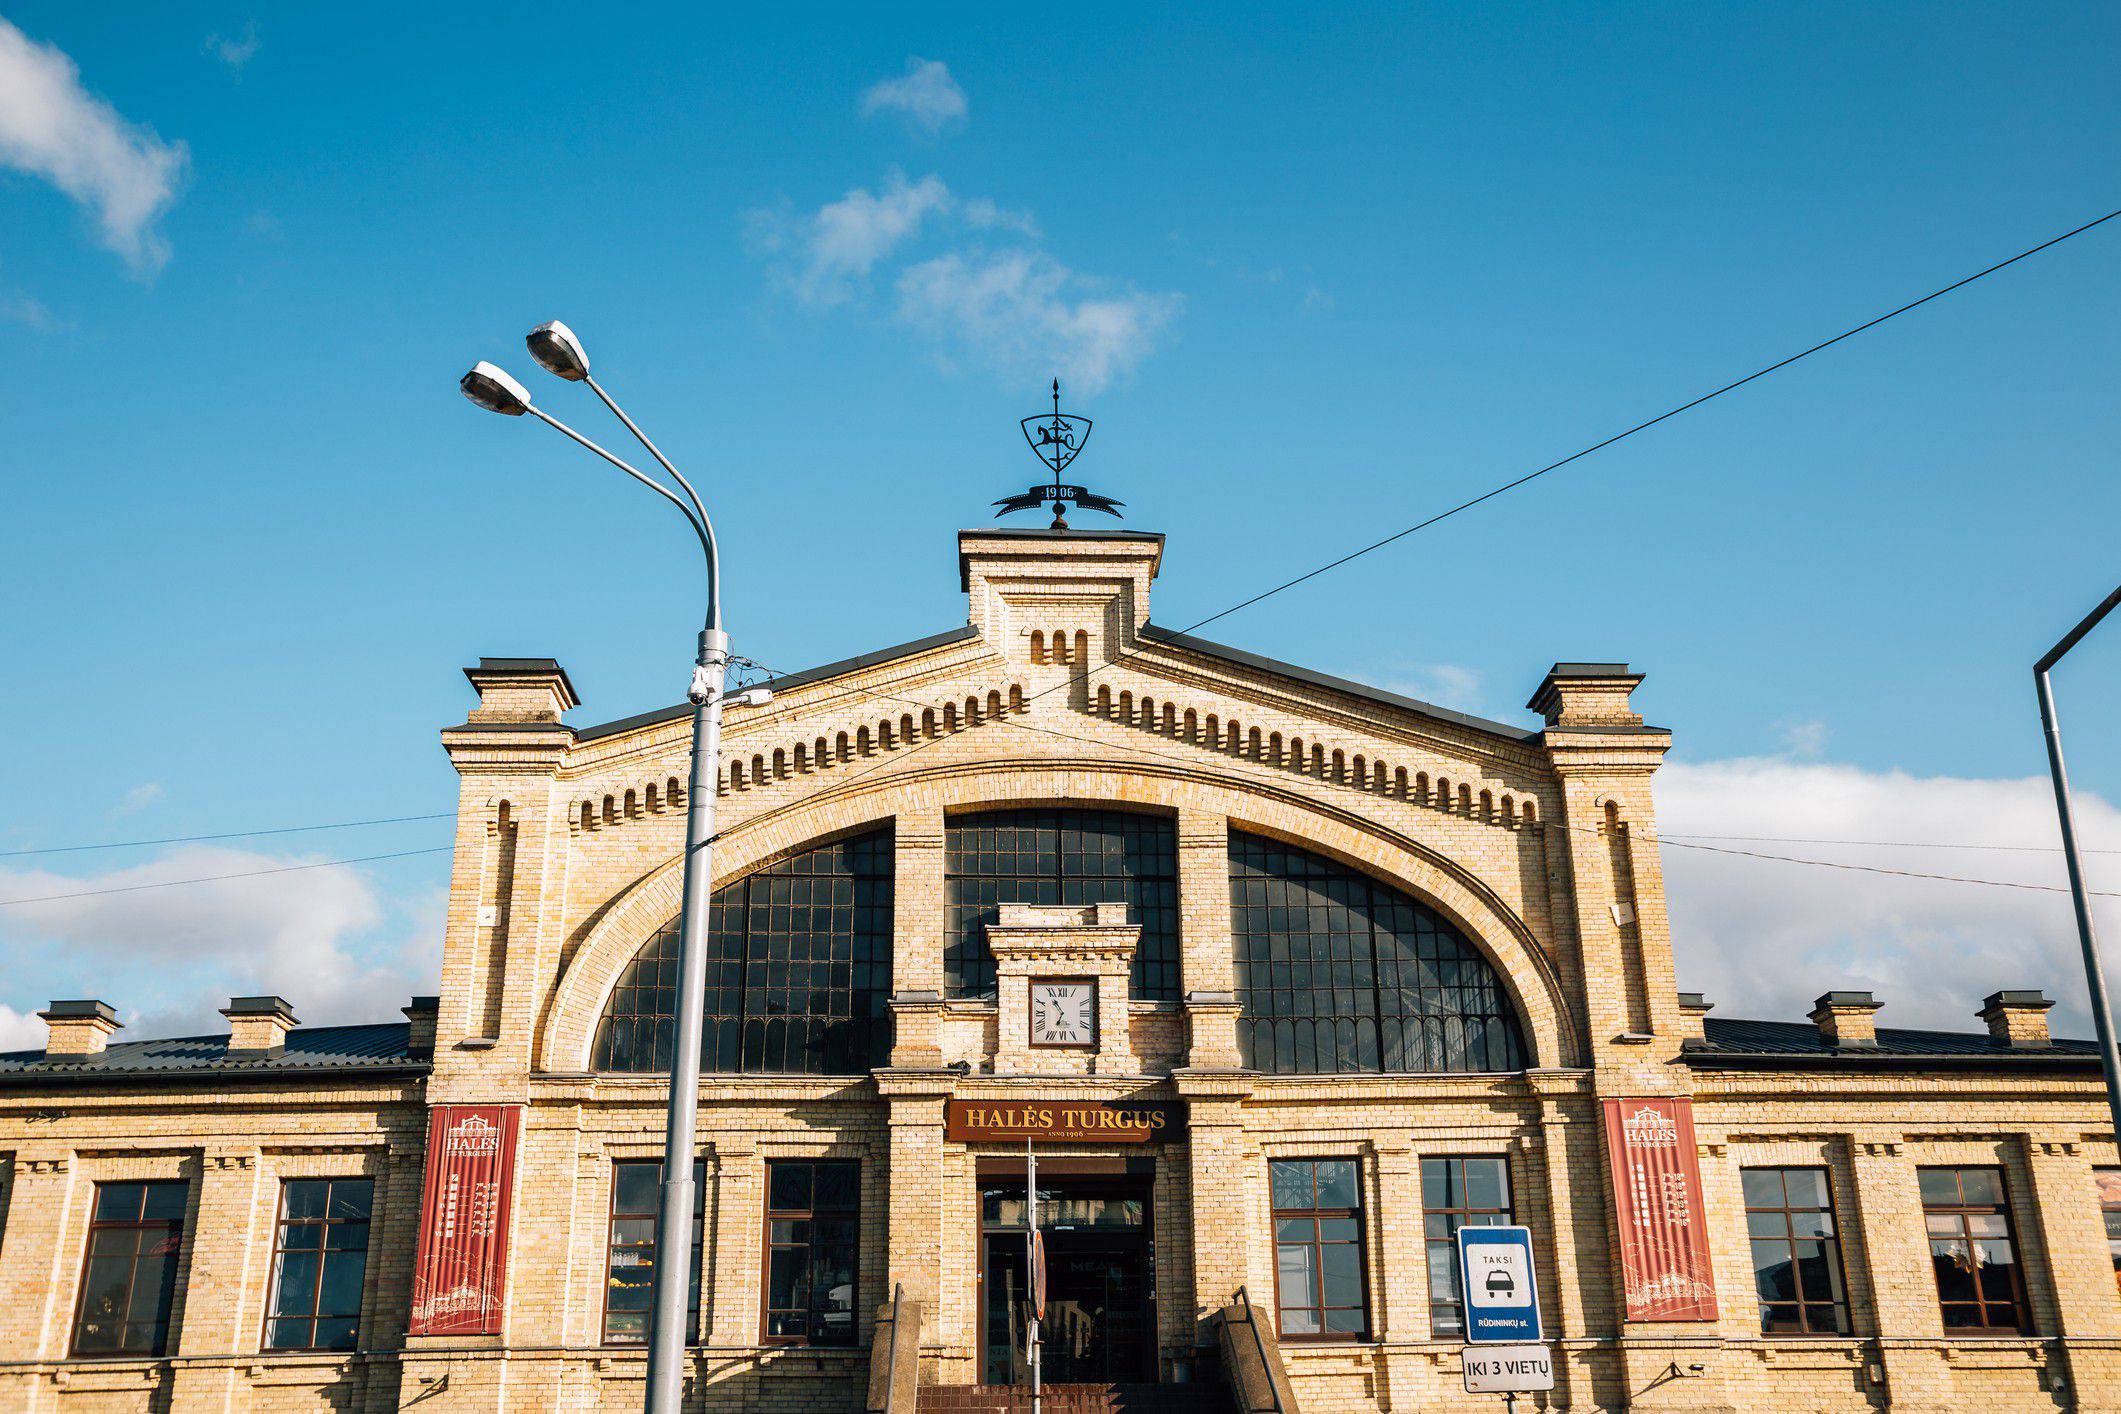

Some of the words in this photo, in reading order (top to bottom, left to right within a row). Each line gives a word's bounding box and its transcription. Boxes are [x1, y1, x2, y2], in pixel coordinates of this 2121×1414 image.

[1045, 487, 1074, 498] 1906
[1058, 988, 1067, 998] XII
[1059, 1031, 1067, 1040] VI
[965, 1105, 1053, 1129] HALĖS
[1061, 1109, 1165, 1129] TURGUS
[1483, 1256, 1513, 1264] TAKSI
[1478, 1318, 1519, 1329] RŪDININKŲ
[1467, 1361, 1487, 1376] IKI
[1492, 1361, 1501, 1375] 3
[1505, 1360, 1549, 1378] VIETŲ
